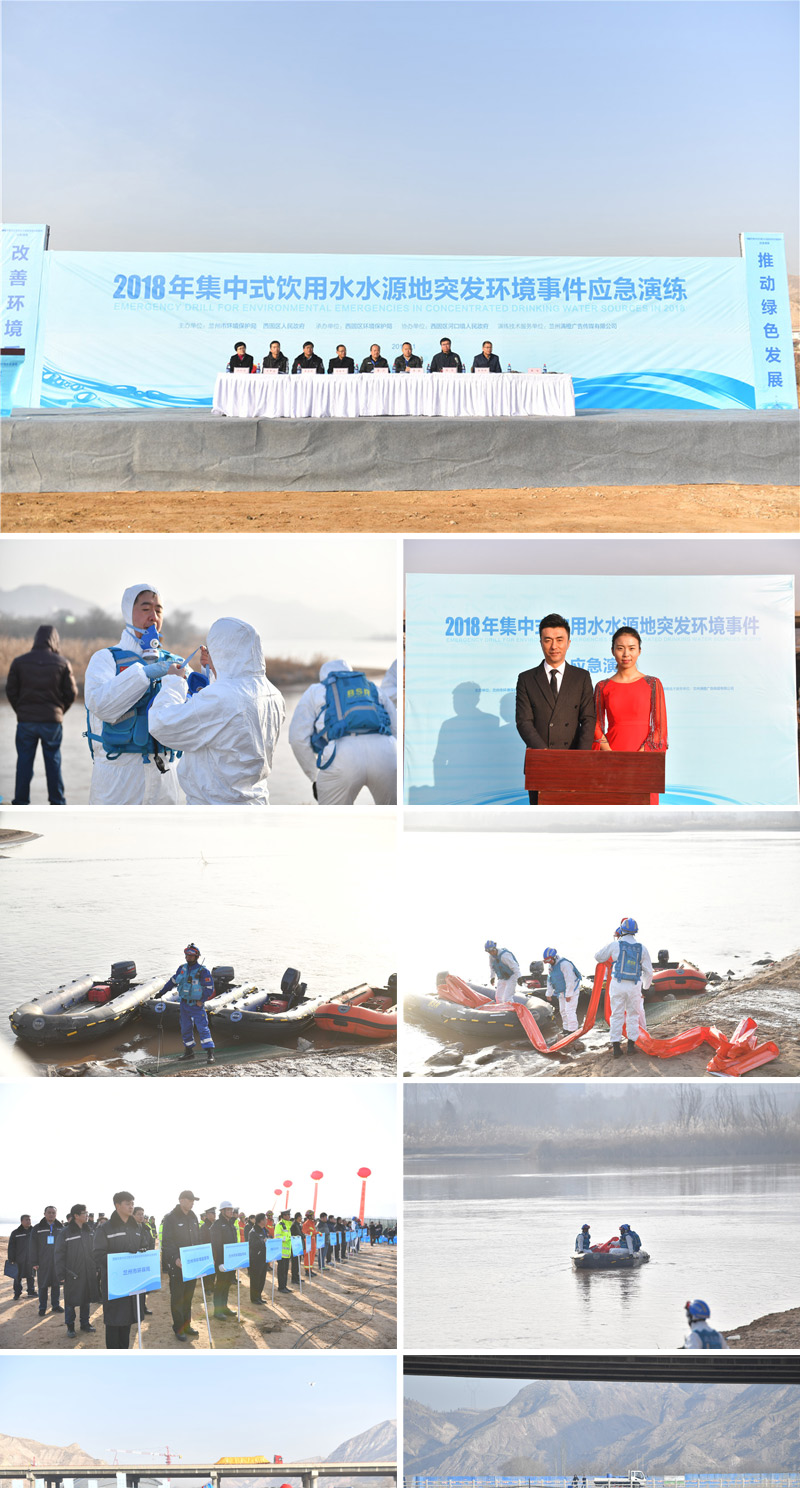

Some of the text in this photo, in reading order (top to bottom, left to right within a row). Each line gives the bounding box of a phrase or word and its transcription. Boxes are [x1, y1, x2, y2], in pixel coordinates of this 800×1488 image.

[4, 244, 30, 349] 改善环境
[113, 273, 687, 302] 2018年集中式饮用水水源地突发环境事件应急演练
[113, 302, 180, 312] EMERGENCY
[185, 303, 214, 312] DRILL
[218, 303, 239, 312] FOR
[242, 303, 332, 313] ENVIRONMENTAL
[335, 304, 409, 313] EMERGENCIES
[412, 304, 423, 312] IN
[425, 304, 508, 313] CONCENTRATED
[511, 304, 560, 313] DRINKING
[562, 304, 598, 313] WATER
[600, 304, 648, 313] SOURCES
[651, 304, 661, 312] IN
[758, 252, 783, 388] 推动绿色发展
[445, 616, 760, 637] 2018年集中用水水源地突发环境事件
